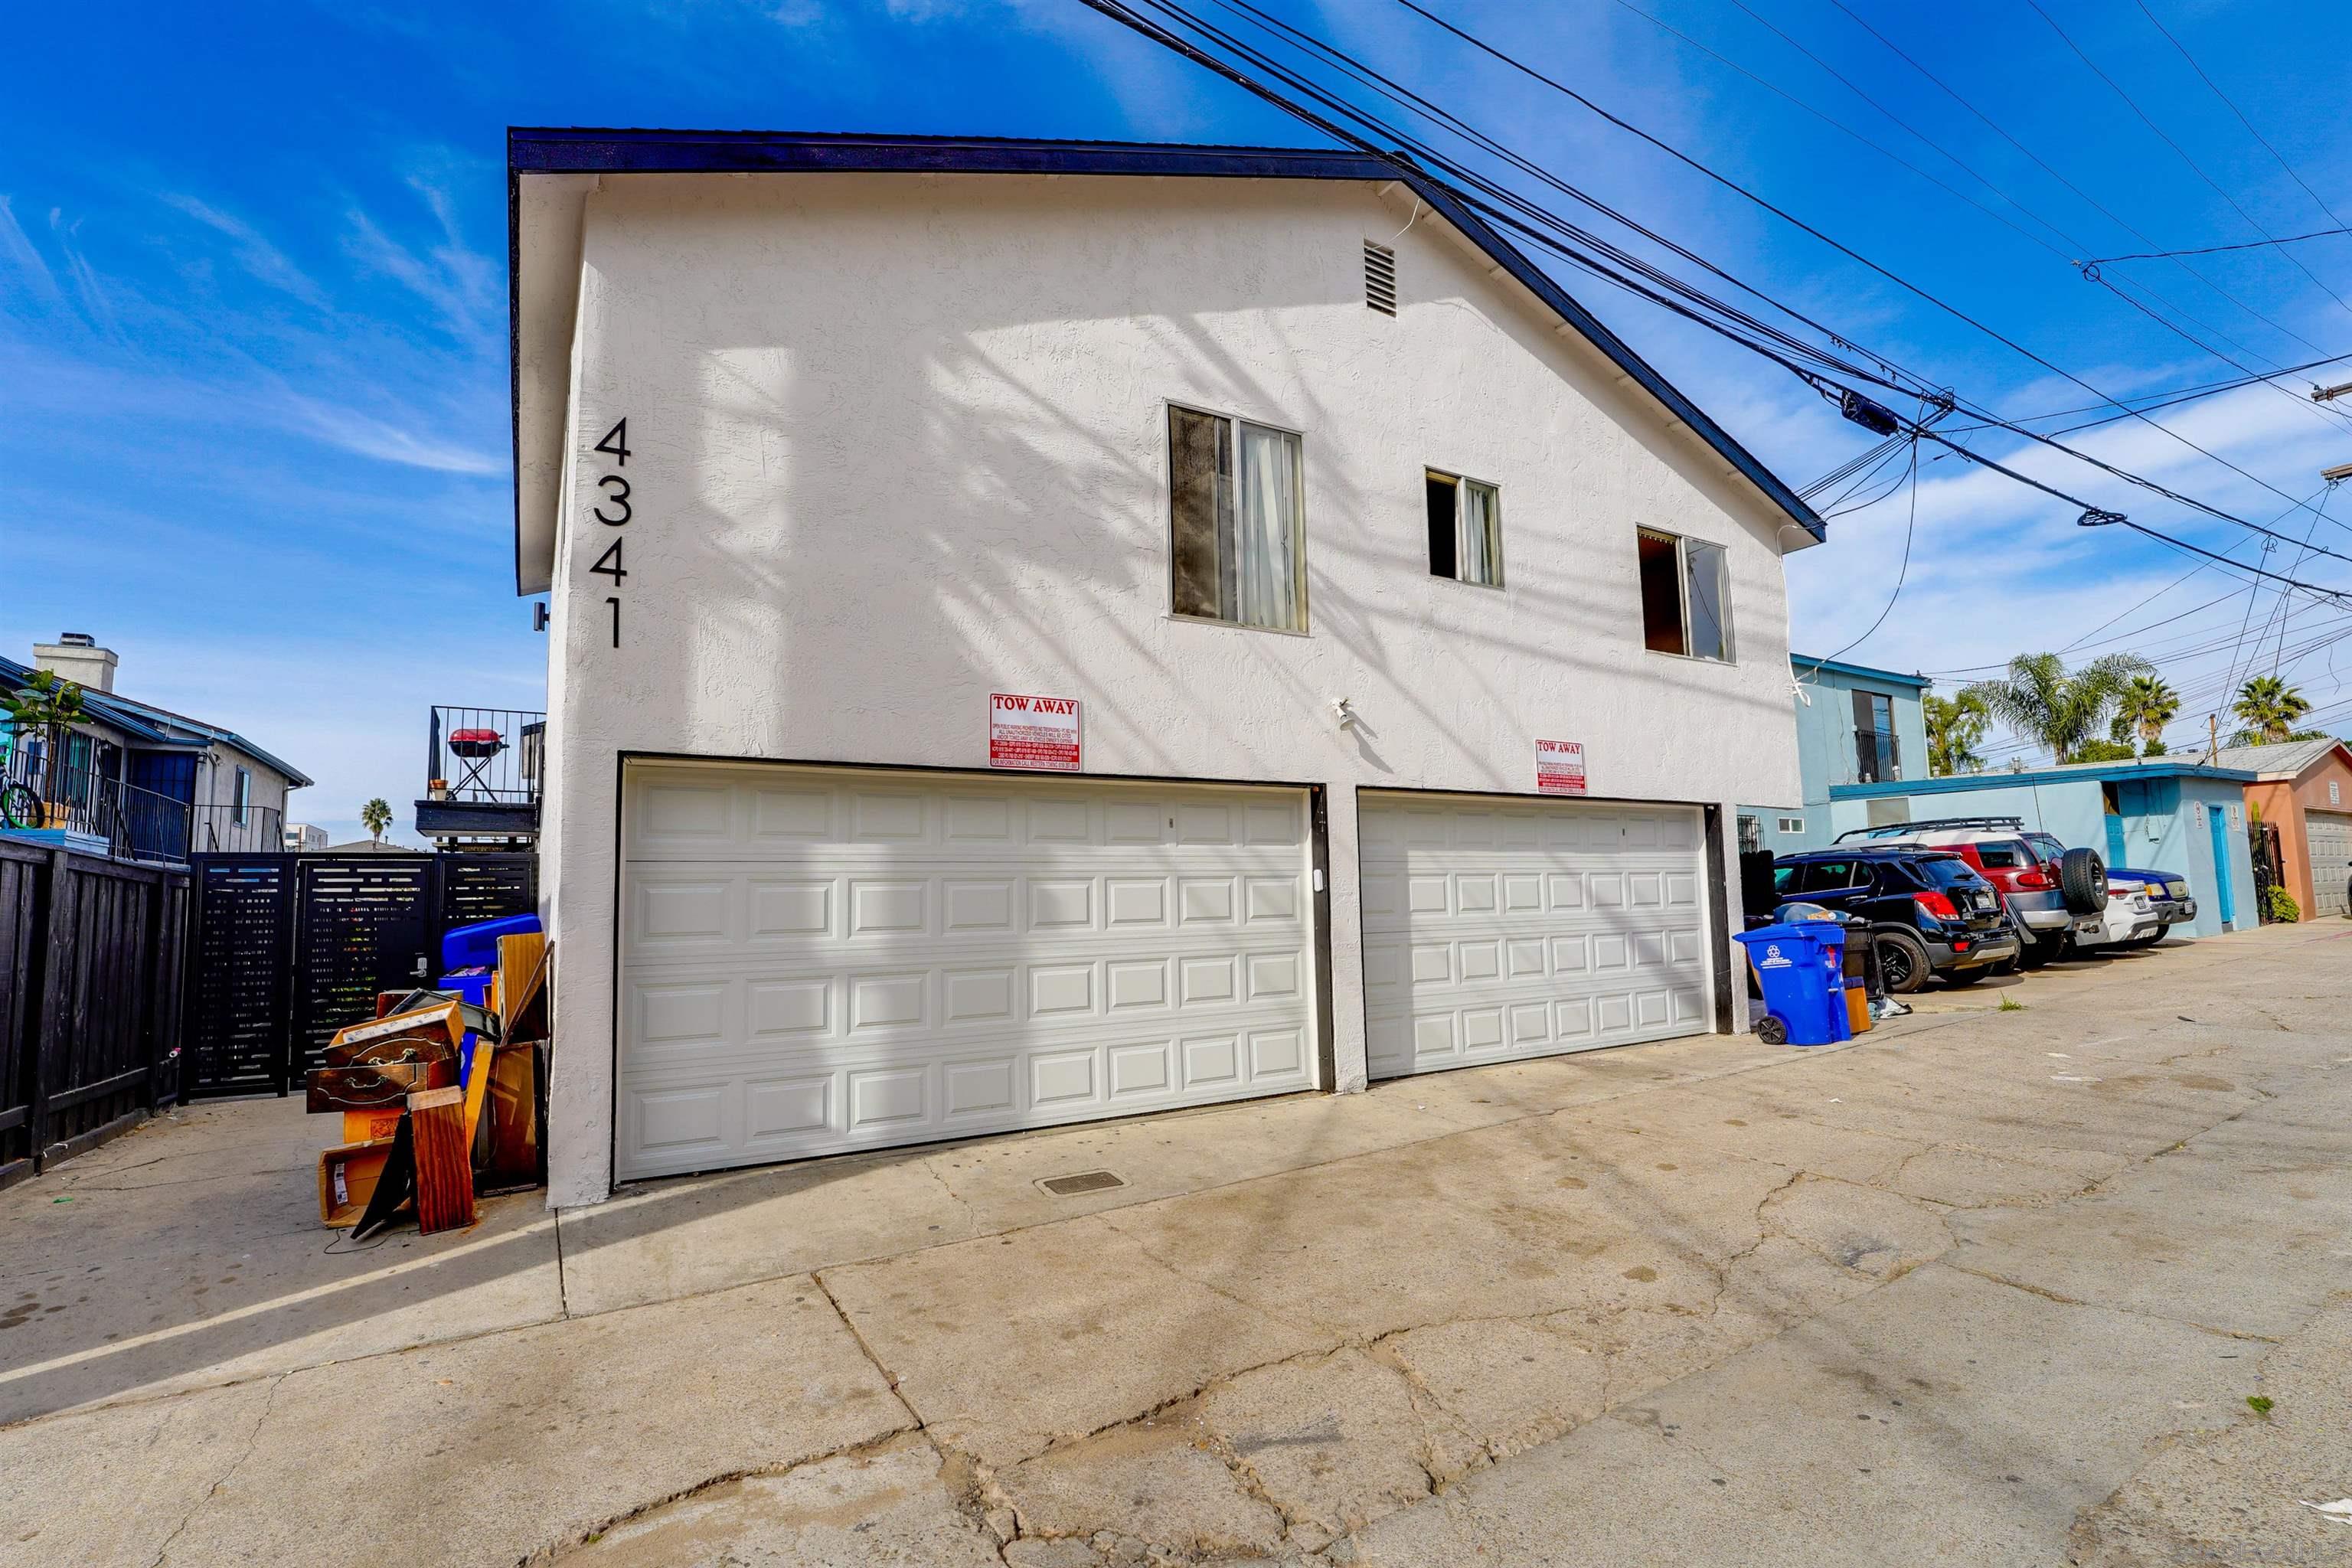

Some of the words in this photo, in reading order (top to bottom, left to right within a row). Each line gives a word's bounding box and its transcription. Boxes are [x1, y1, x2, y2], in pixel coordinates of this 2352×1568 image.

[589, 416, 632, 648] 4341
[993, 697, 1029, 710] TOW
[1033, 700, 1074, 714] AWAY
[1537, 741, 1556, 752] TOW
[1558, 743, 1580, 754] AWAY
